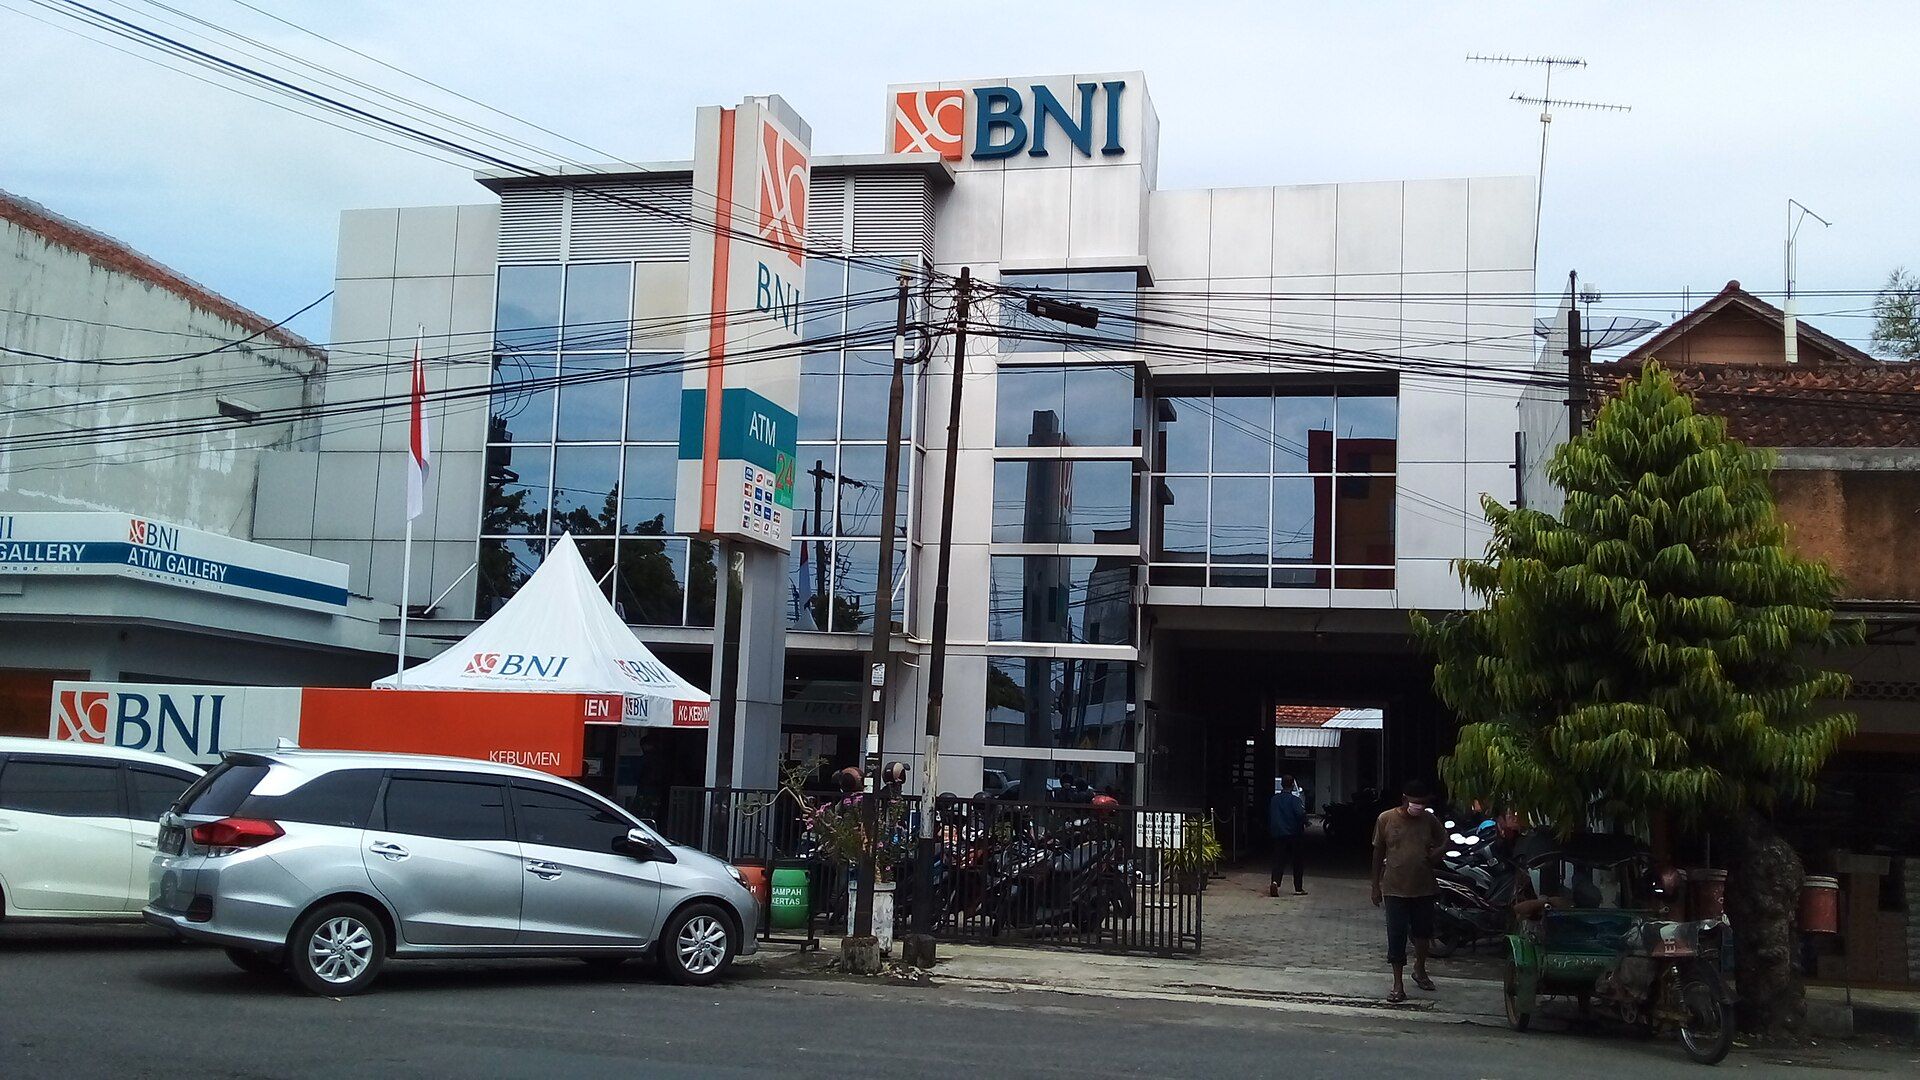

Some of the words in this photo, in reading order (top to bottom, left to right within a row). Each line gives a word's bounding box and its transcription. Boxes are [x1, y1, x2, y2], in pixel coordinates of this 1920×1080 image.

[970, 81, 1125, 161] BNI
[756, 259, 800, 337] BNI
[748, 410, 778, 448] ATM
[776, 453, 793, 495] 24
[146, 522, 179, 551] BNI
[0, 543, 86, 562] GALLERY
[127, 546, 161, 570] ATM
[166, 554, 227, 582] GALLERY
[498, 654, 569, 677] BNI
[627, 660, 671, 683] BNI
[584, 699, 609, 717] EN
[634, 698, 648, 717] BN
[678, 705, 688, 721] KC
[115, 692, 225, 756] BNI
[489, 750, 561, 766] KEBUMEN
[772, 887, 802, 896] SAMPAH
